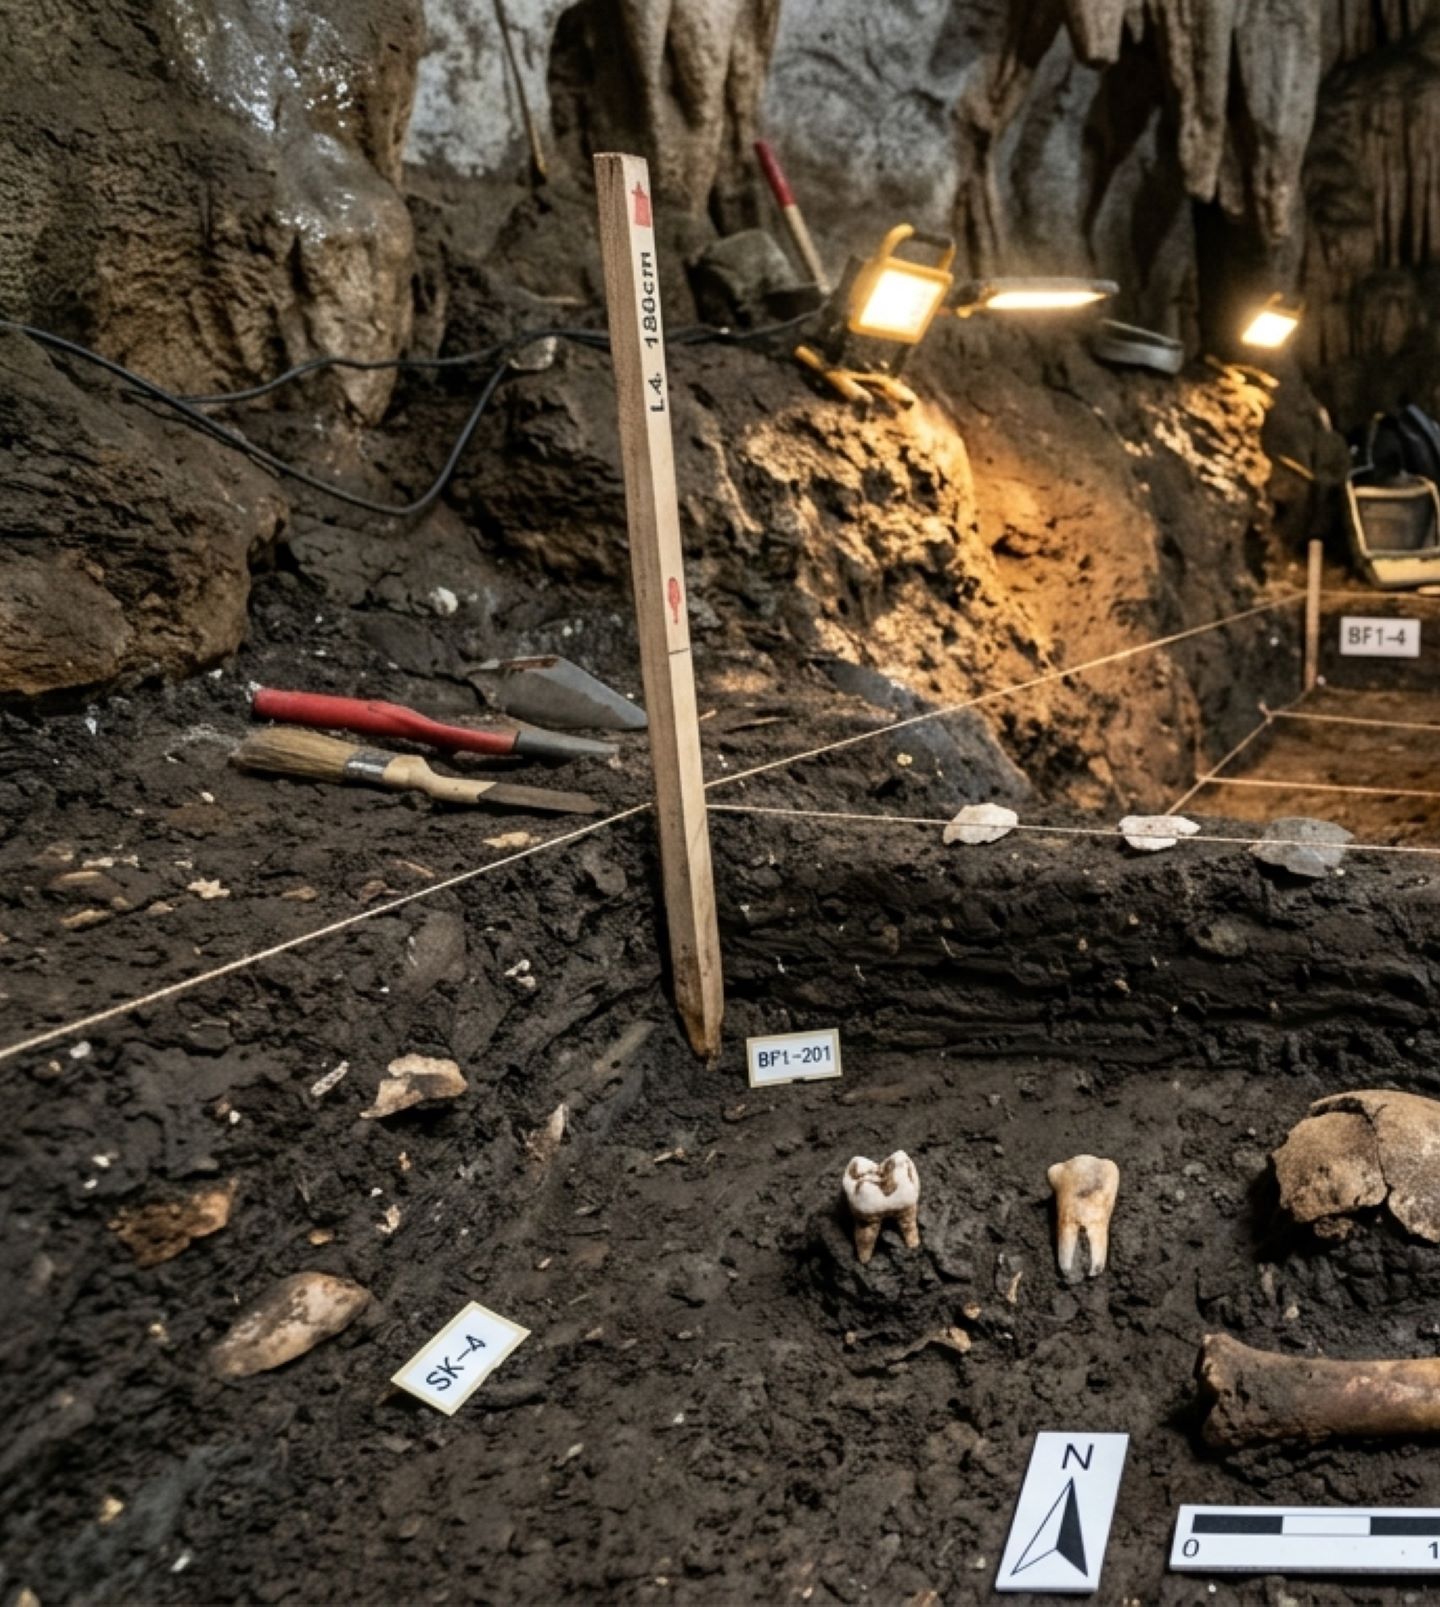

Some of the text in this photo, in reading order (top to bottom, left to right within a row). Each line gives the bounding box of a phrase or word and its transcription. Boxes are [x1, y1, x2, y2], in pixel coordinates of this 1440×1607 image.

[640, 252, 659, 349] 180cm
[1348, 625, 1406, 647] BF1-4
[758, 1045, 831, 1068] BF1-201
[1061, 1442, 1094, 1471] N
[1181, 1537, 1200, 1559] 0
